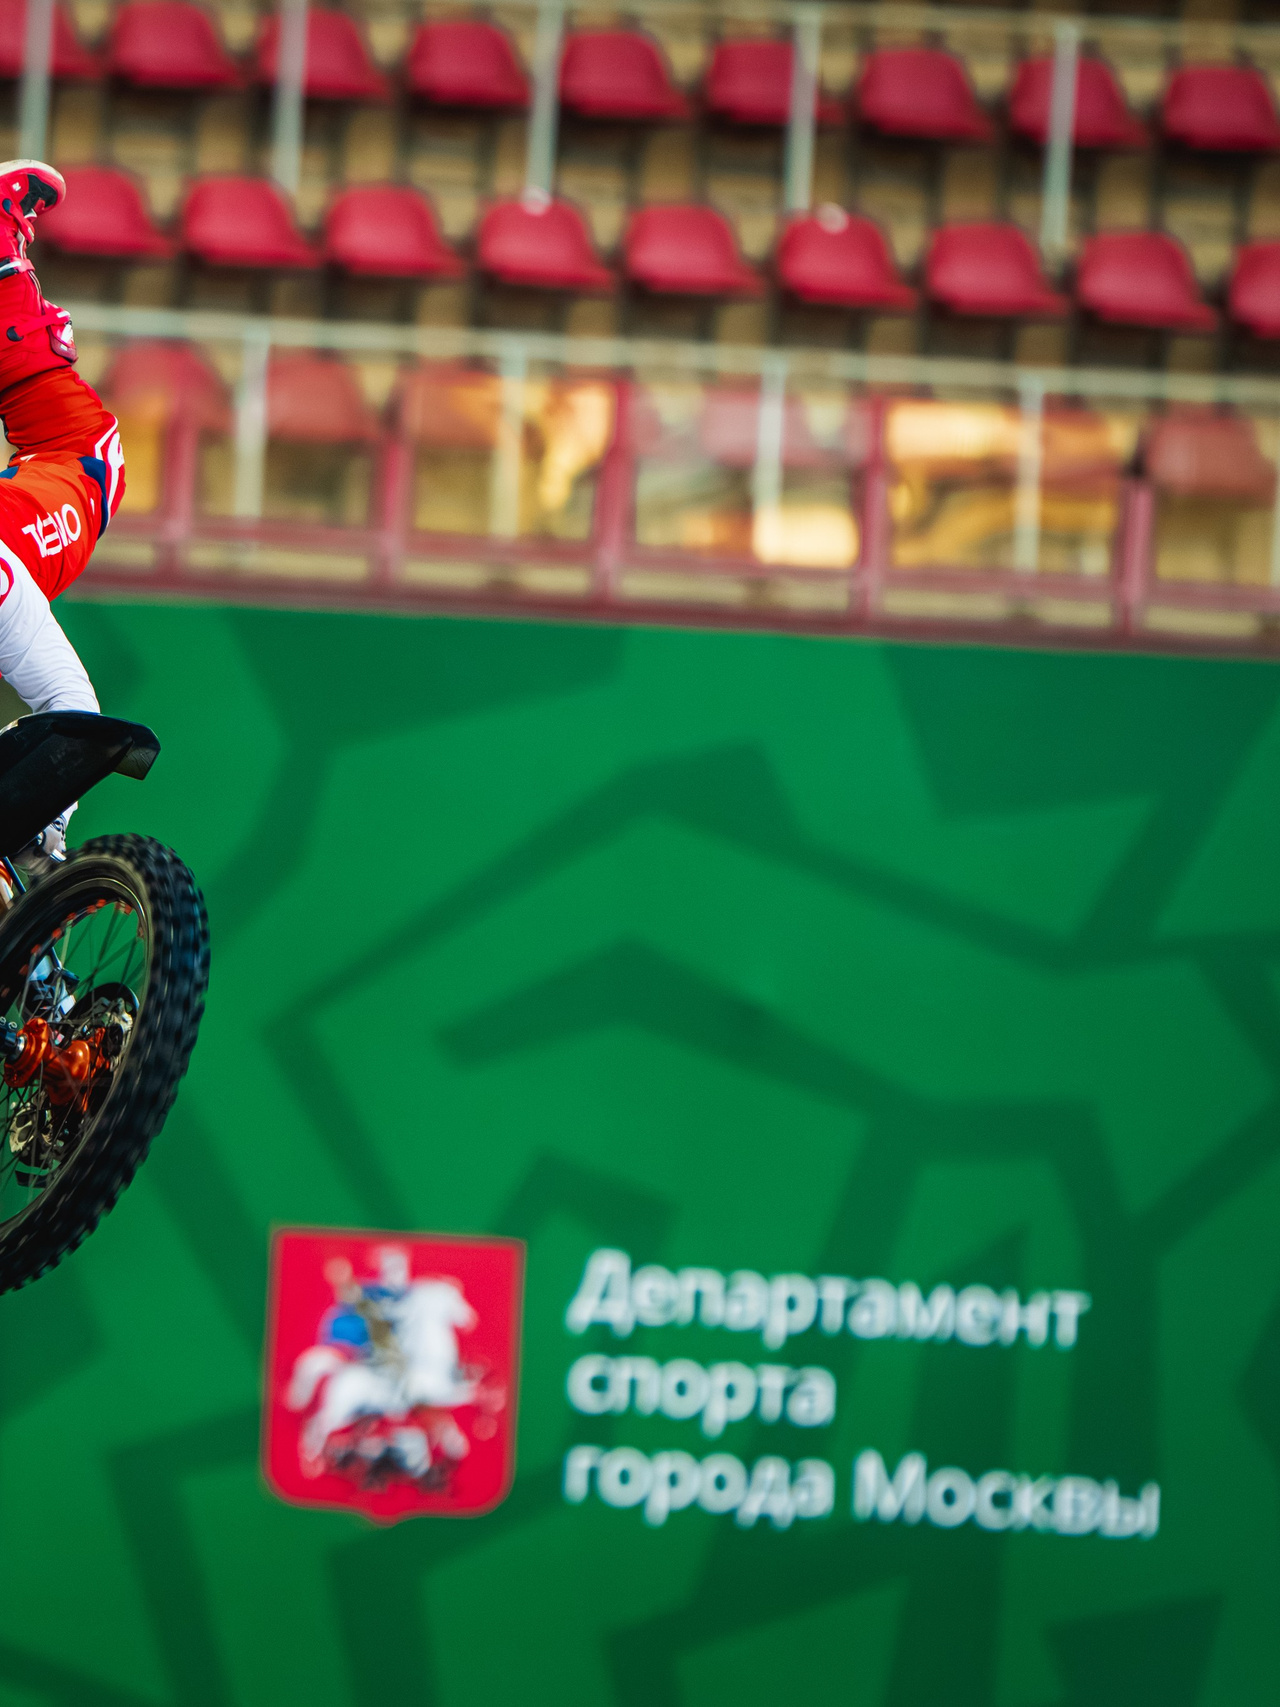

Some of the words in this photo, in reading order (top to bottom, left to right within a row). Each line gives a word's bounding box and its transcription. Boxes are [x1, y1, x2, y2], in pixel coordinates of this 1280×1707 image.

[569, 1251, 1081, 1344] Департамент
[570, 1356, 834, 1431] спорта
[568, 1448, 833, 1522] города
[856, 1453, 1159, 1534] Москвы
